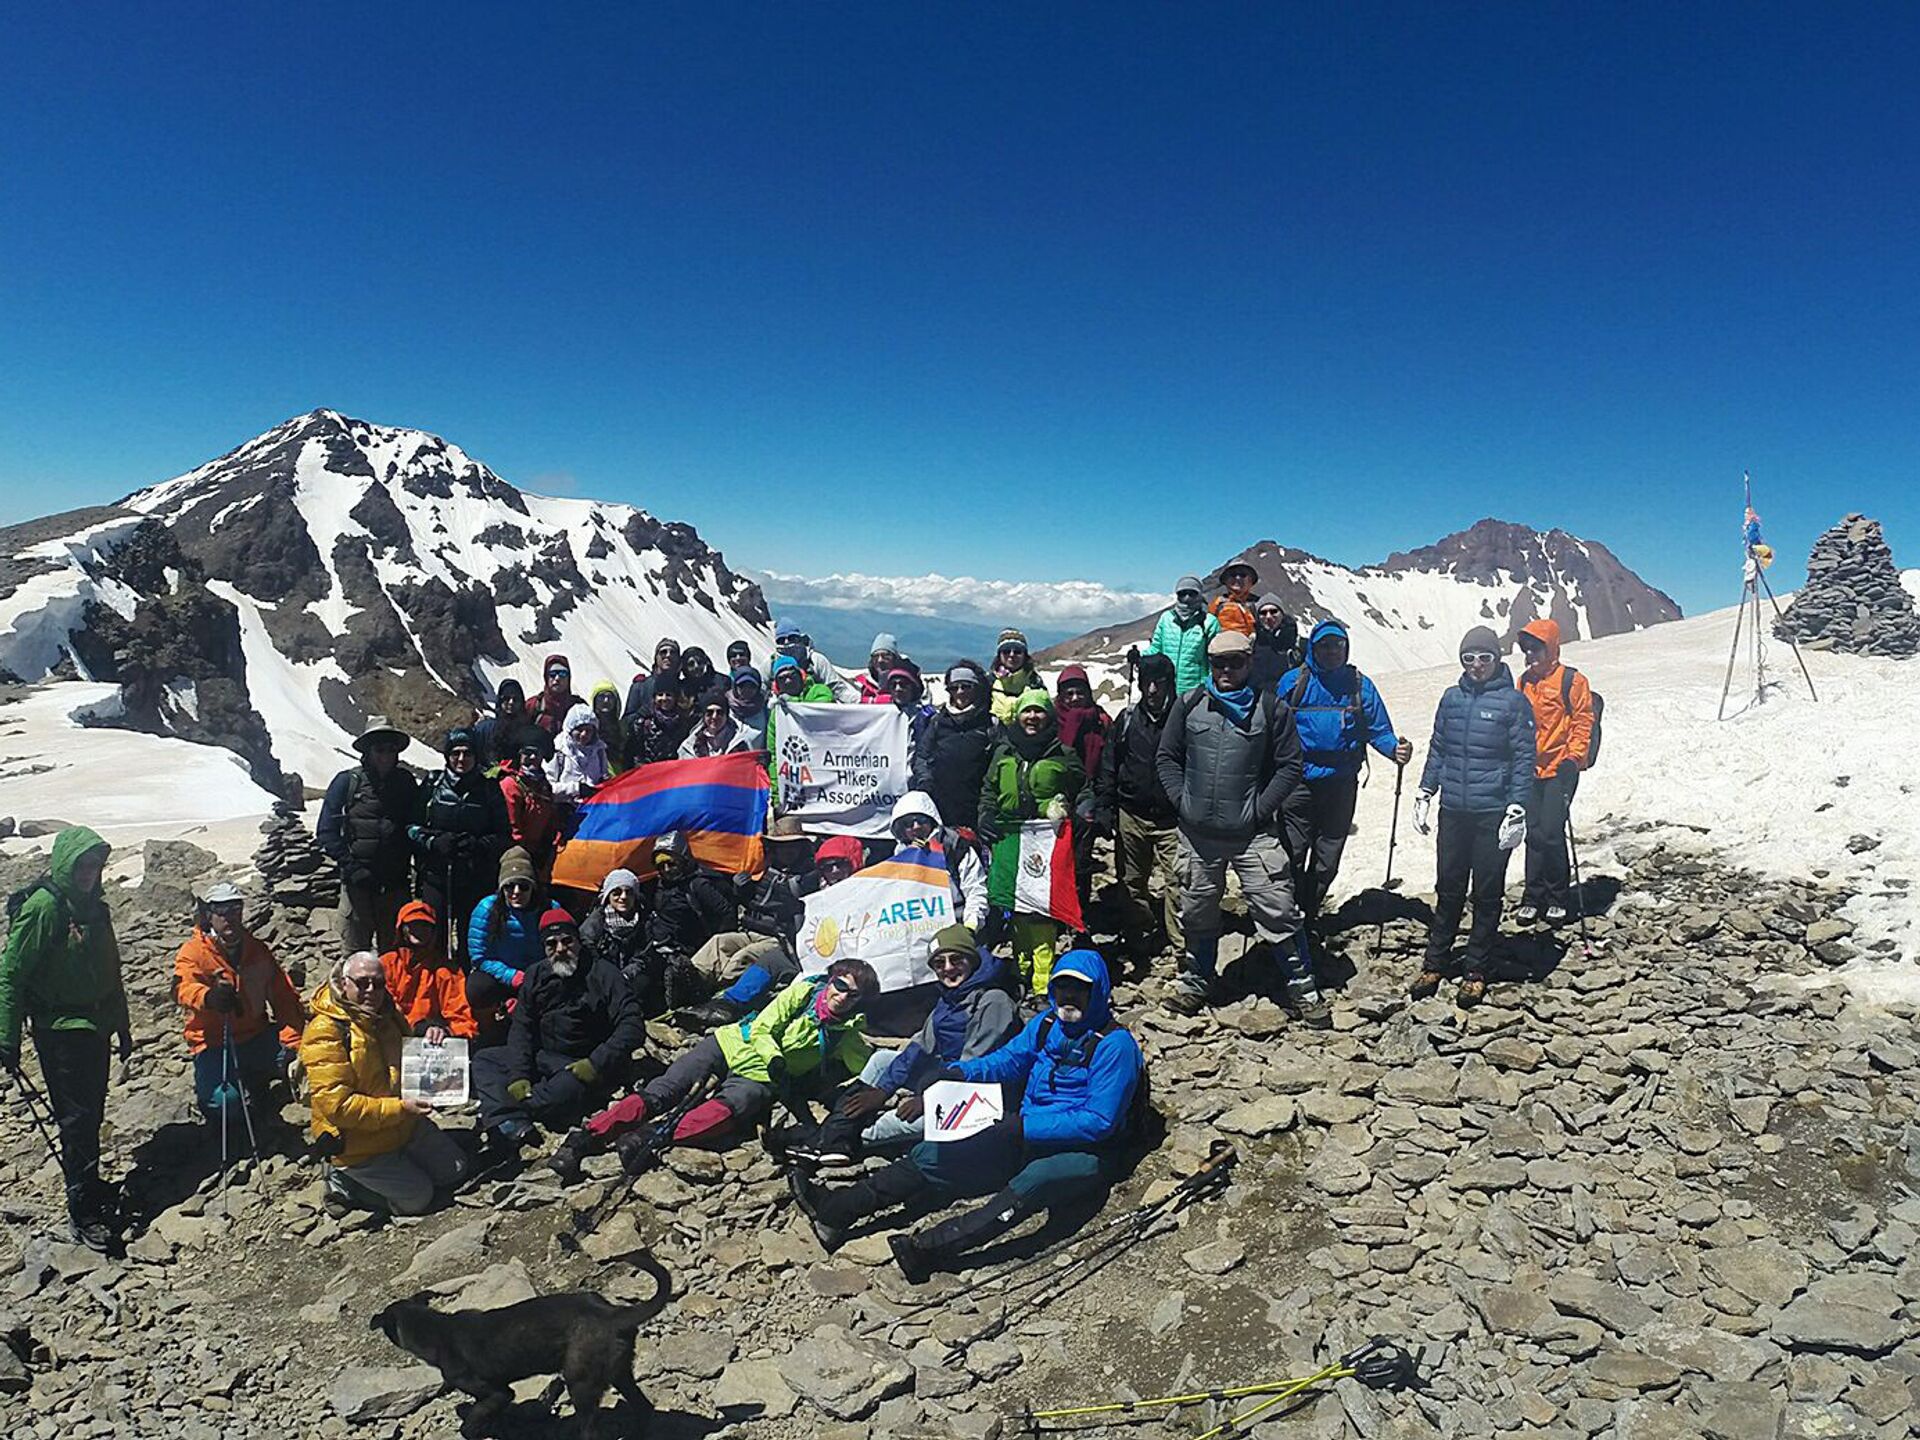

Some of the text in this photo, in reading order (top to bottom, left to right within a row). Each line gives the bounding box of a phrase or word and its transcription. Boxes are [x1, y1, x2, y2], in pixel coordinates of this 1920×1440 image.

[823, 750, 889, 768] Armenian
[778, 761, 813, 785] AHA
[837, 770, 878, 787] Hikers
[877, 895, 945, 927] AREVI
